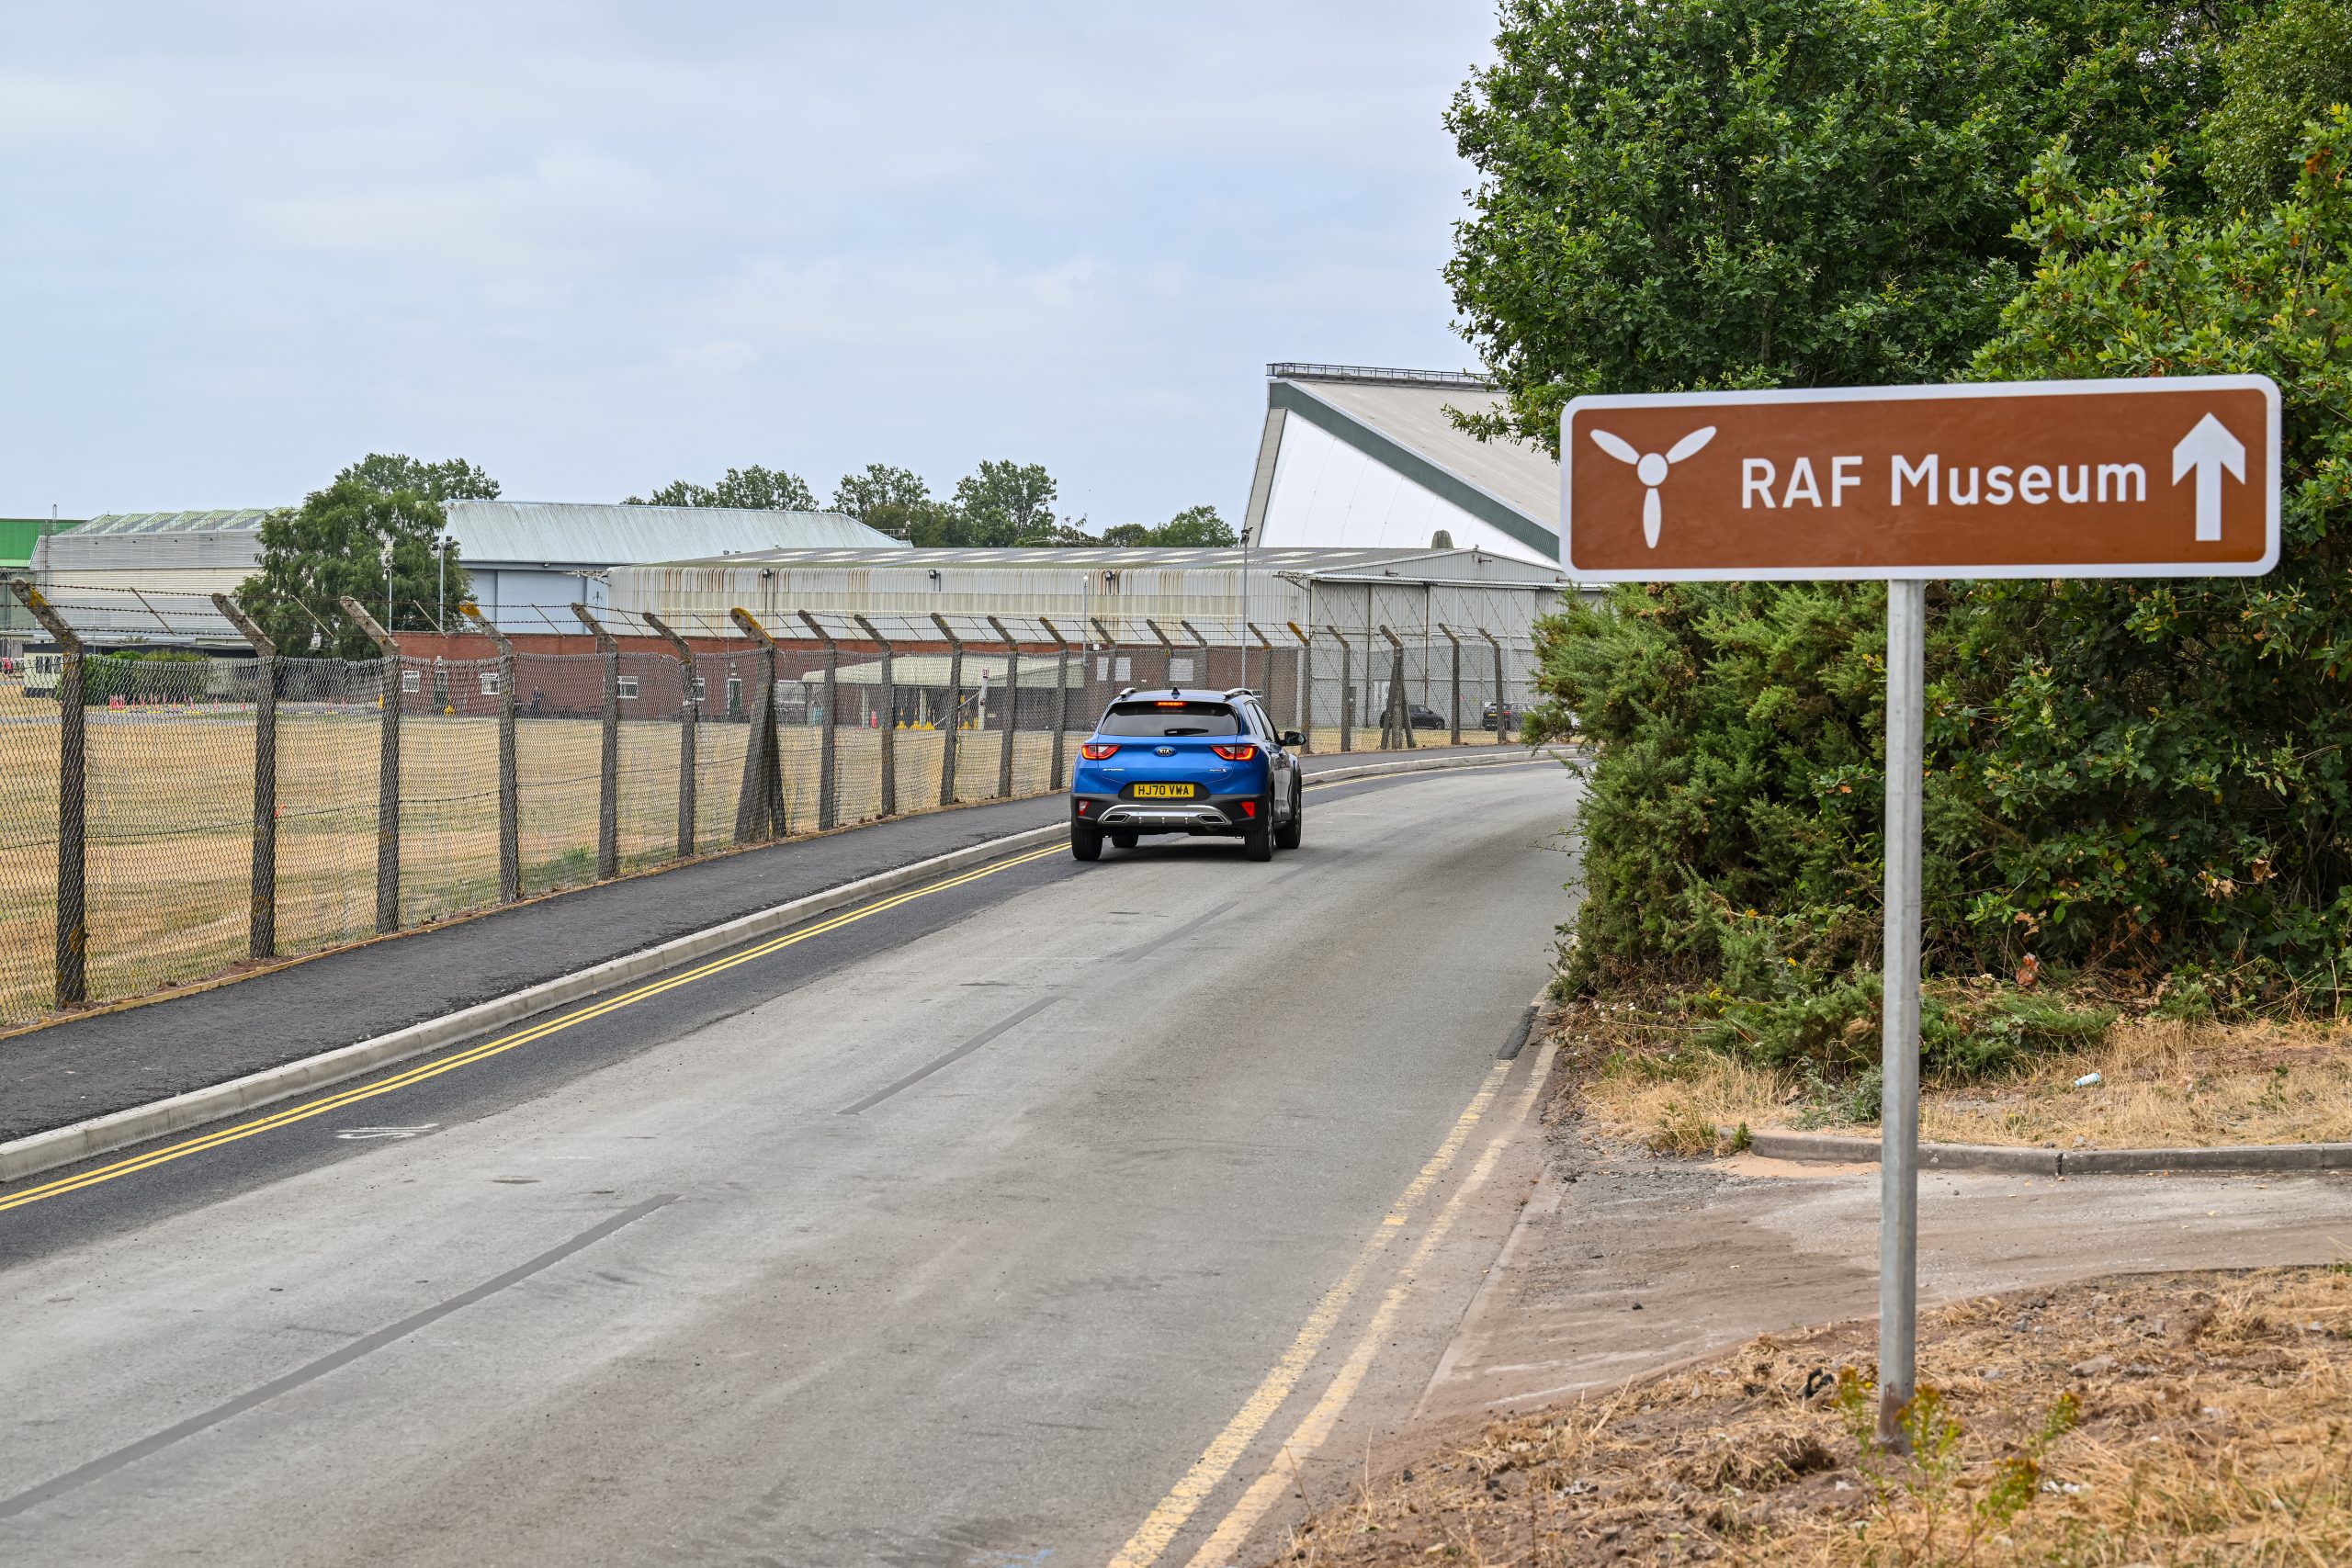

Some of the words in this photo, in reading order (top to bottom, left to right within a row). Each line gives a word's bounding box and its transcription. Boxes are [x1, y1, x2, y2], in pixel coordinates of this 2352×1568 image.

[1742, 457, 1862, 509] RAF
[1890, 454, 2147, 506] Museum
[1138, 784, 1166, 795] HJ70
[1169, 784, 1189, 795] VWA
